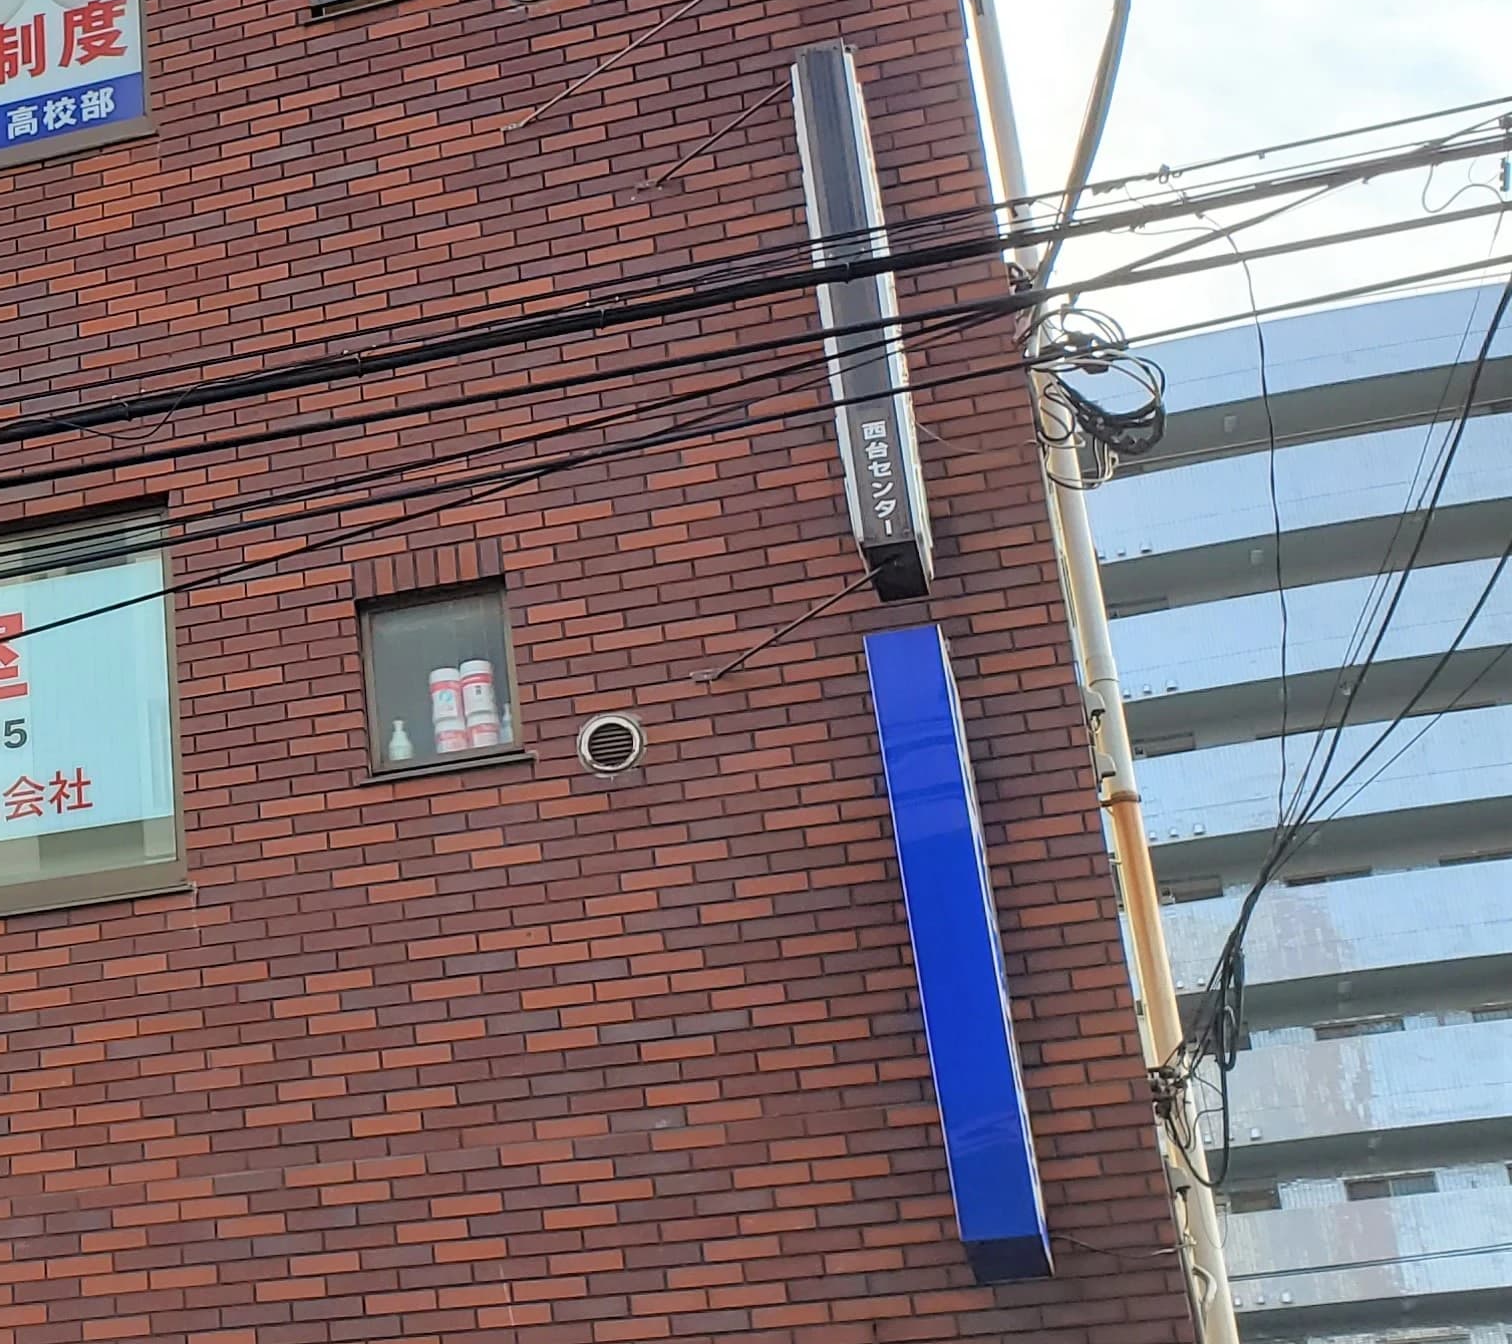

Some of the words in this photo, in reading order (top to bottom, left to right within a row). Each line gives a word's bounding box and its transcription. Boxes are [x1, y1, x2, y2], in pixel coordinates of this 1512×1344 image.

[861, 420, 897, 536] 西台センター
